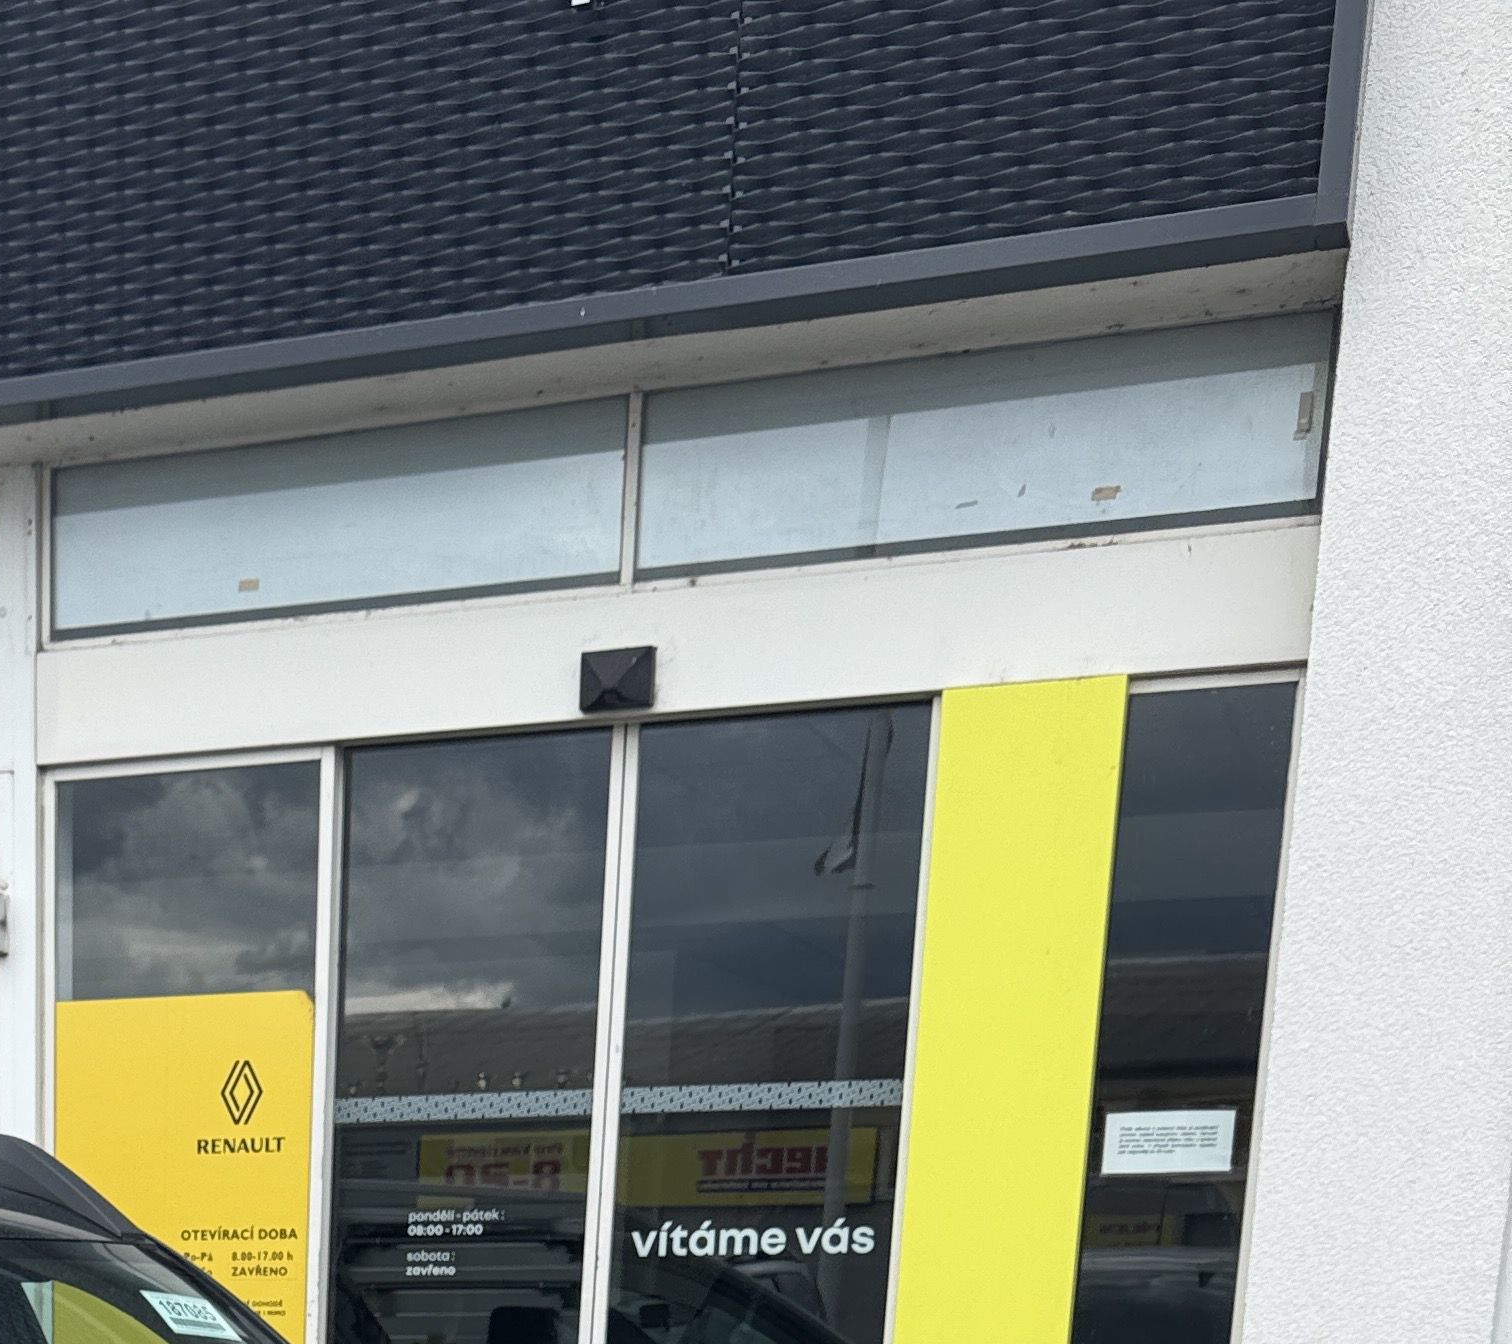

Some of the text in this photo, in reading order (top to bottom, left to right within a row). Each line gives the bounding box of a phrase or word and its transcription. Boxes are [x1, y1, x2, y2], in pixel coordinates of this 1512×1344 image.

[196, 1136, 286, 1155] RENAULT
[180, 1225, 299, 1241] OTEVÍRACÍ DOBA
[631, 1217, 876, 1258] vítáme vás
[231, 1264, 289, 1277] ZAVŘENO
